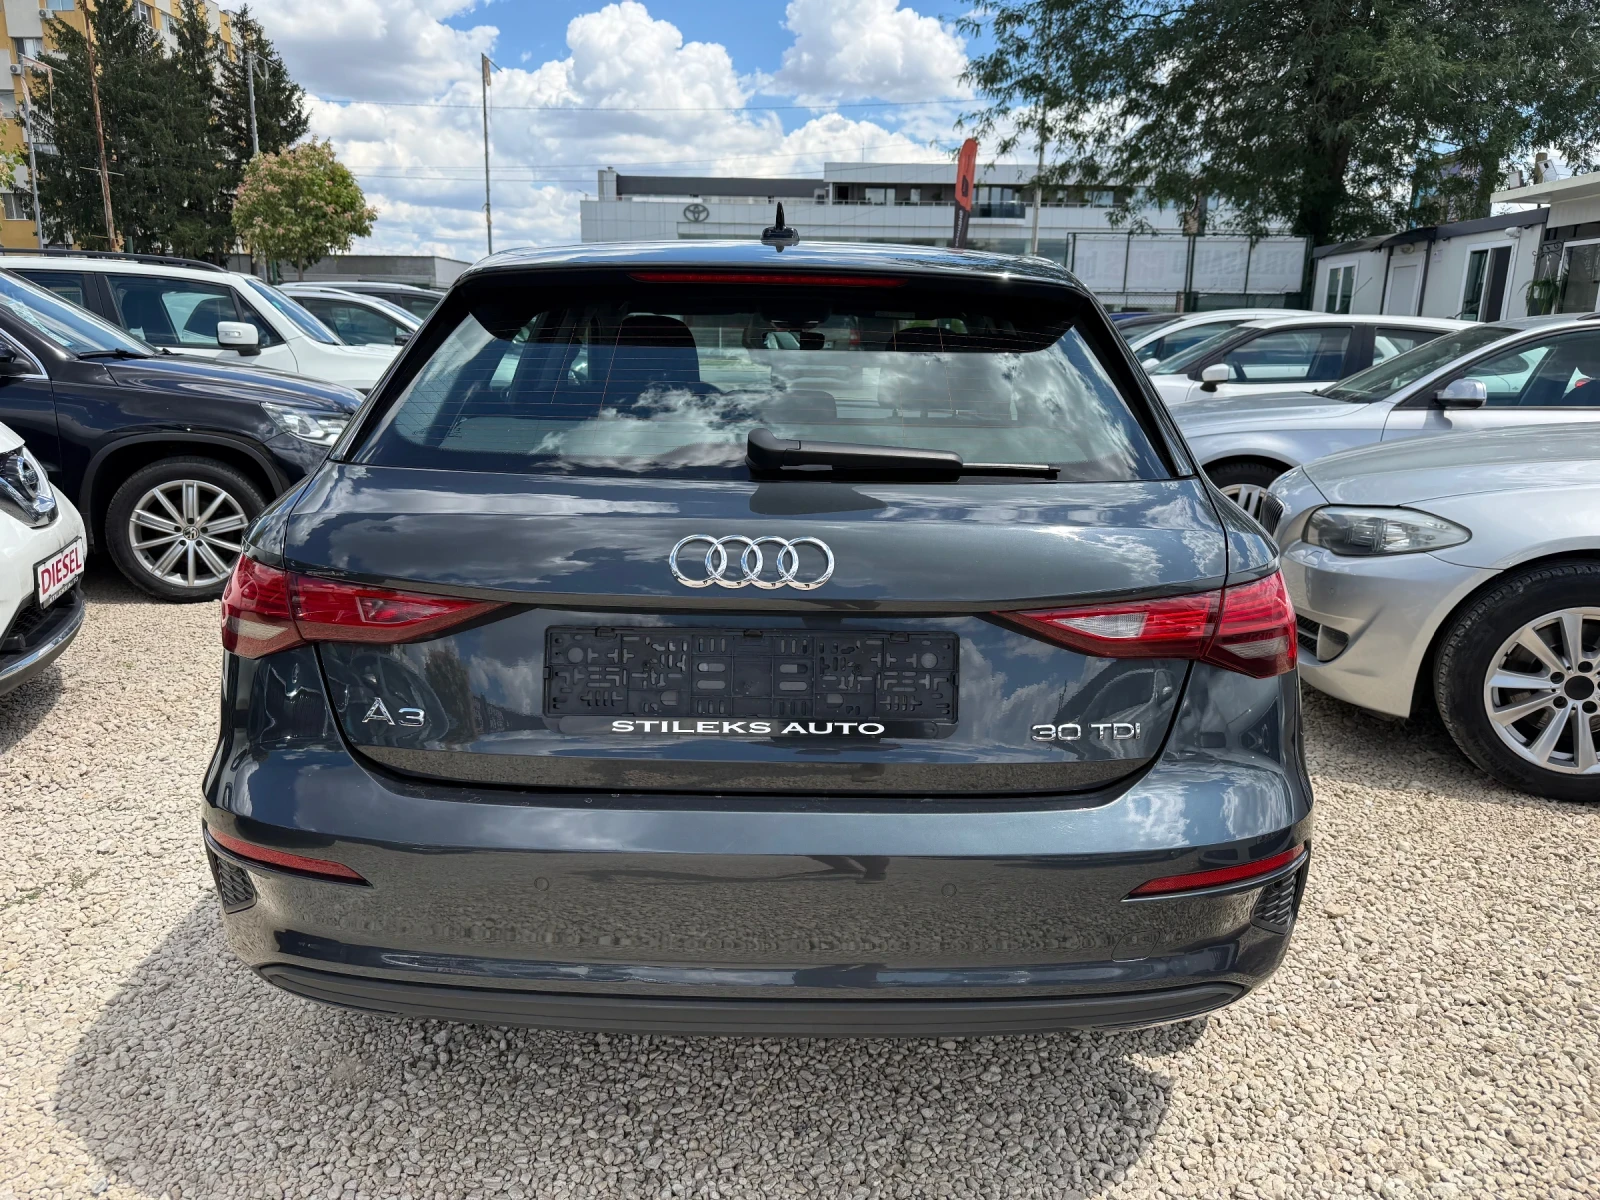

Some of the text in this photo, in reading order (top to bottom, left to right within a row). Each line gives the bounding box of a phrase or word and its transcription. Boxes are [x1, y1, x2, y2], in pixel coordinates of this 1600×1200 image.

[41, 546, 82, 596] DIESEL
[361, 697, 425, 727] A3
[611, 720, 885, 735] STILEKS AUTO
[1031, 722, 1141, 742] 30 TDI
